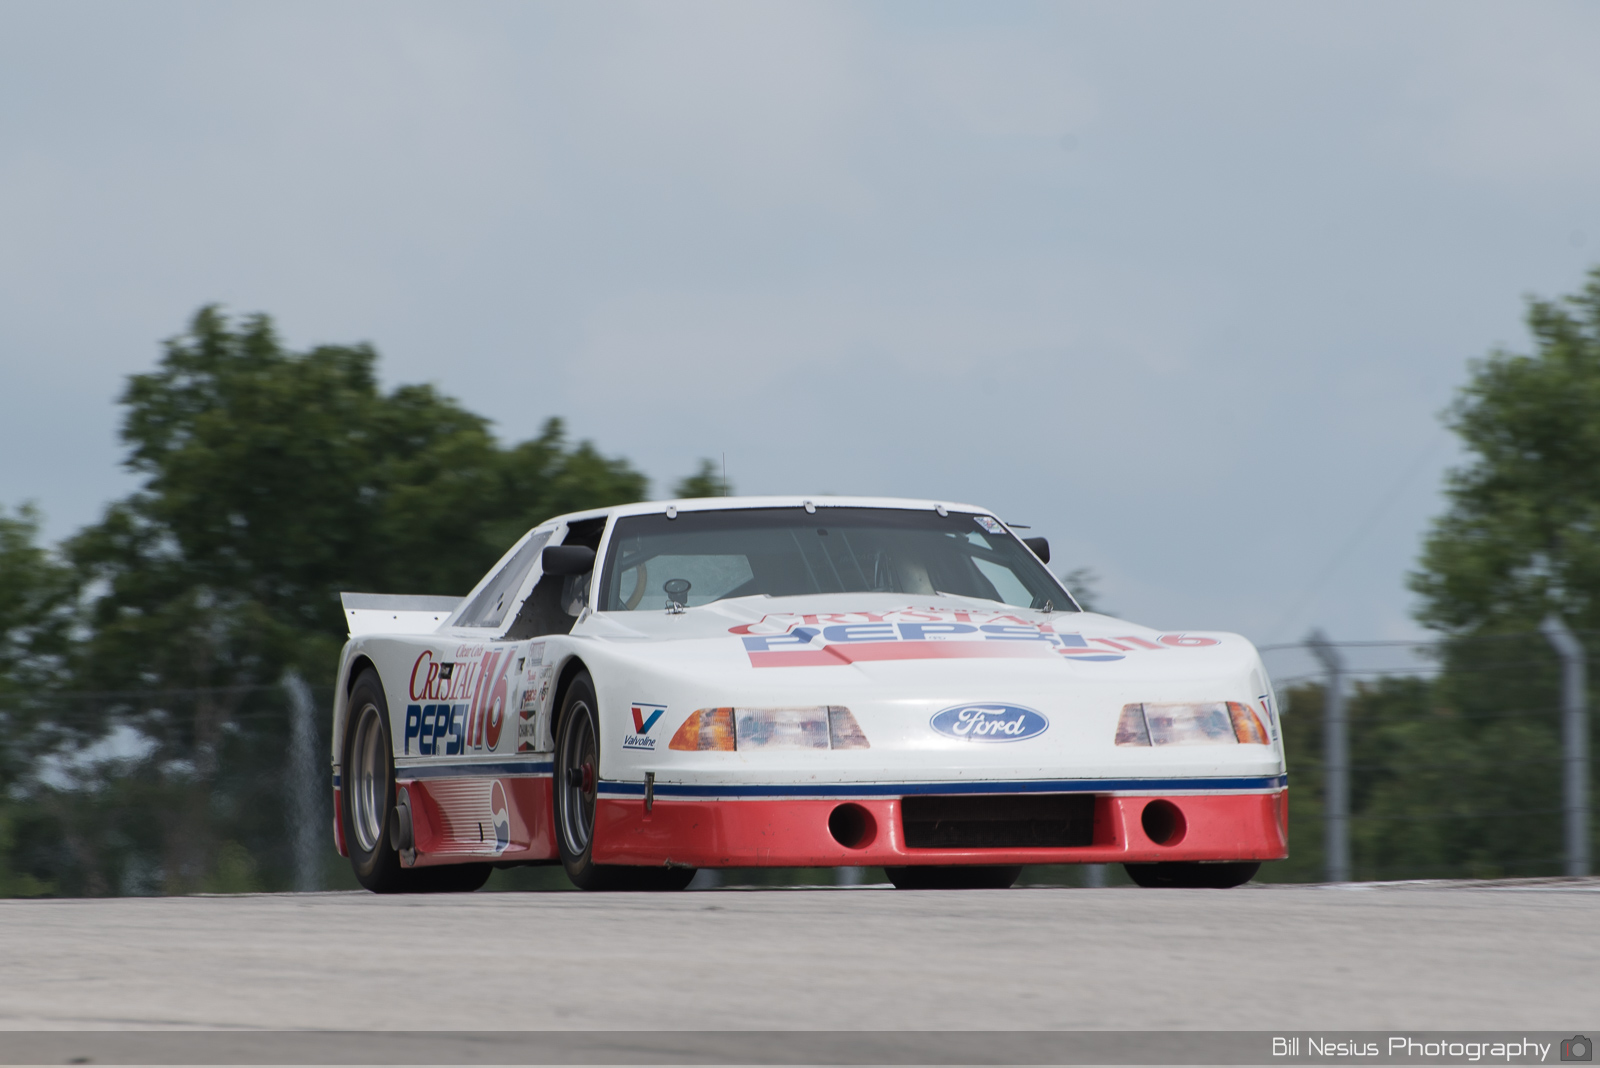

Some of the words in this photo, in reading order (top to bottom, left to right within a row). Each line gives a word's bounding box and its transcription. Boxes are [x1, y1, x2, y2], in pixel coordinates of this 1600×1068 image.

[728, 610, 1079, 635] CRYSTAL
[741, 621, 1088, 651] PEPSI
[456, 644, 471, 658] Clear
[471, 643, 484, 657] Cola
[1087, 634, 1221, 651] 116
[467, 646, 518, 752] 116
[404, 704, 469, 755] PEPSI
[952, 707, 1026, 736] Ford
[624, 735, 656, 746] Valvoline
